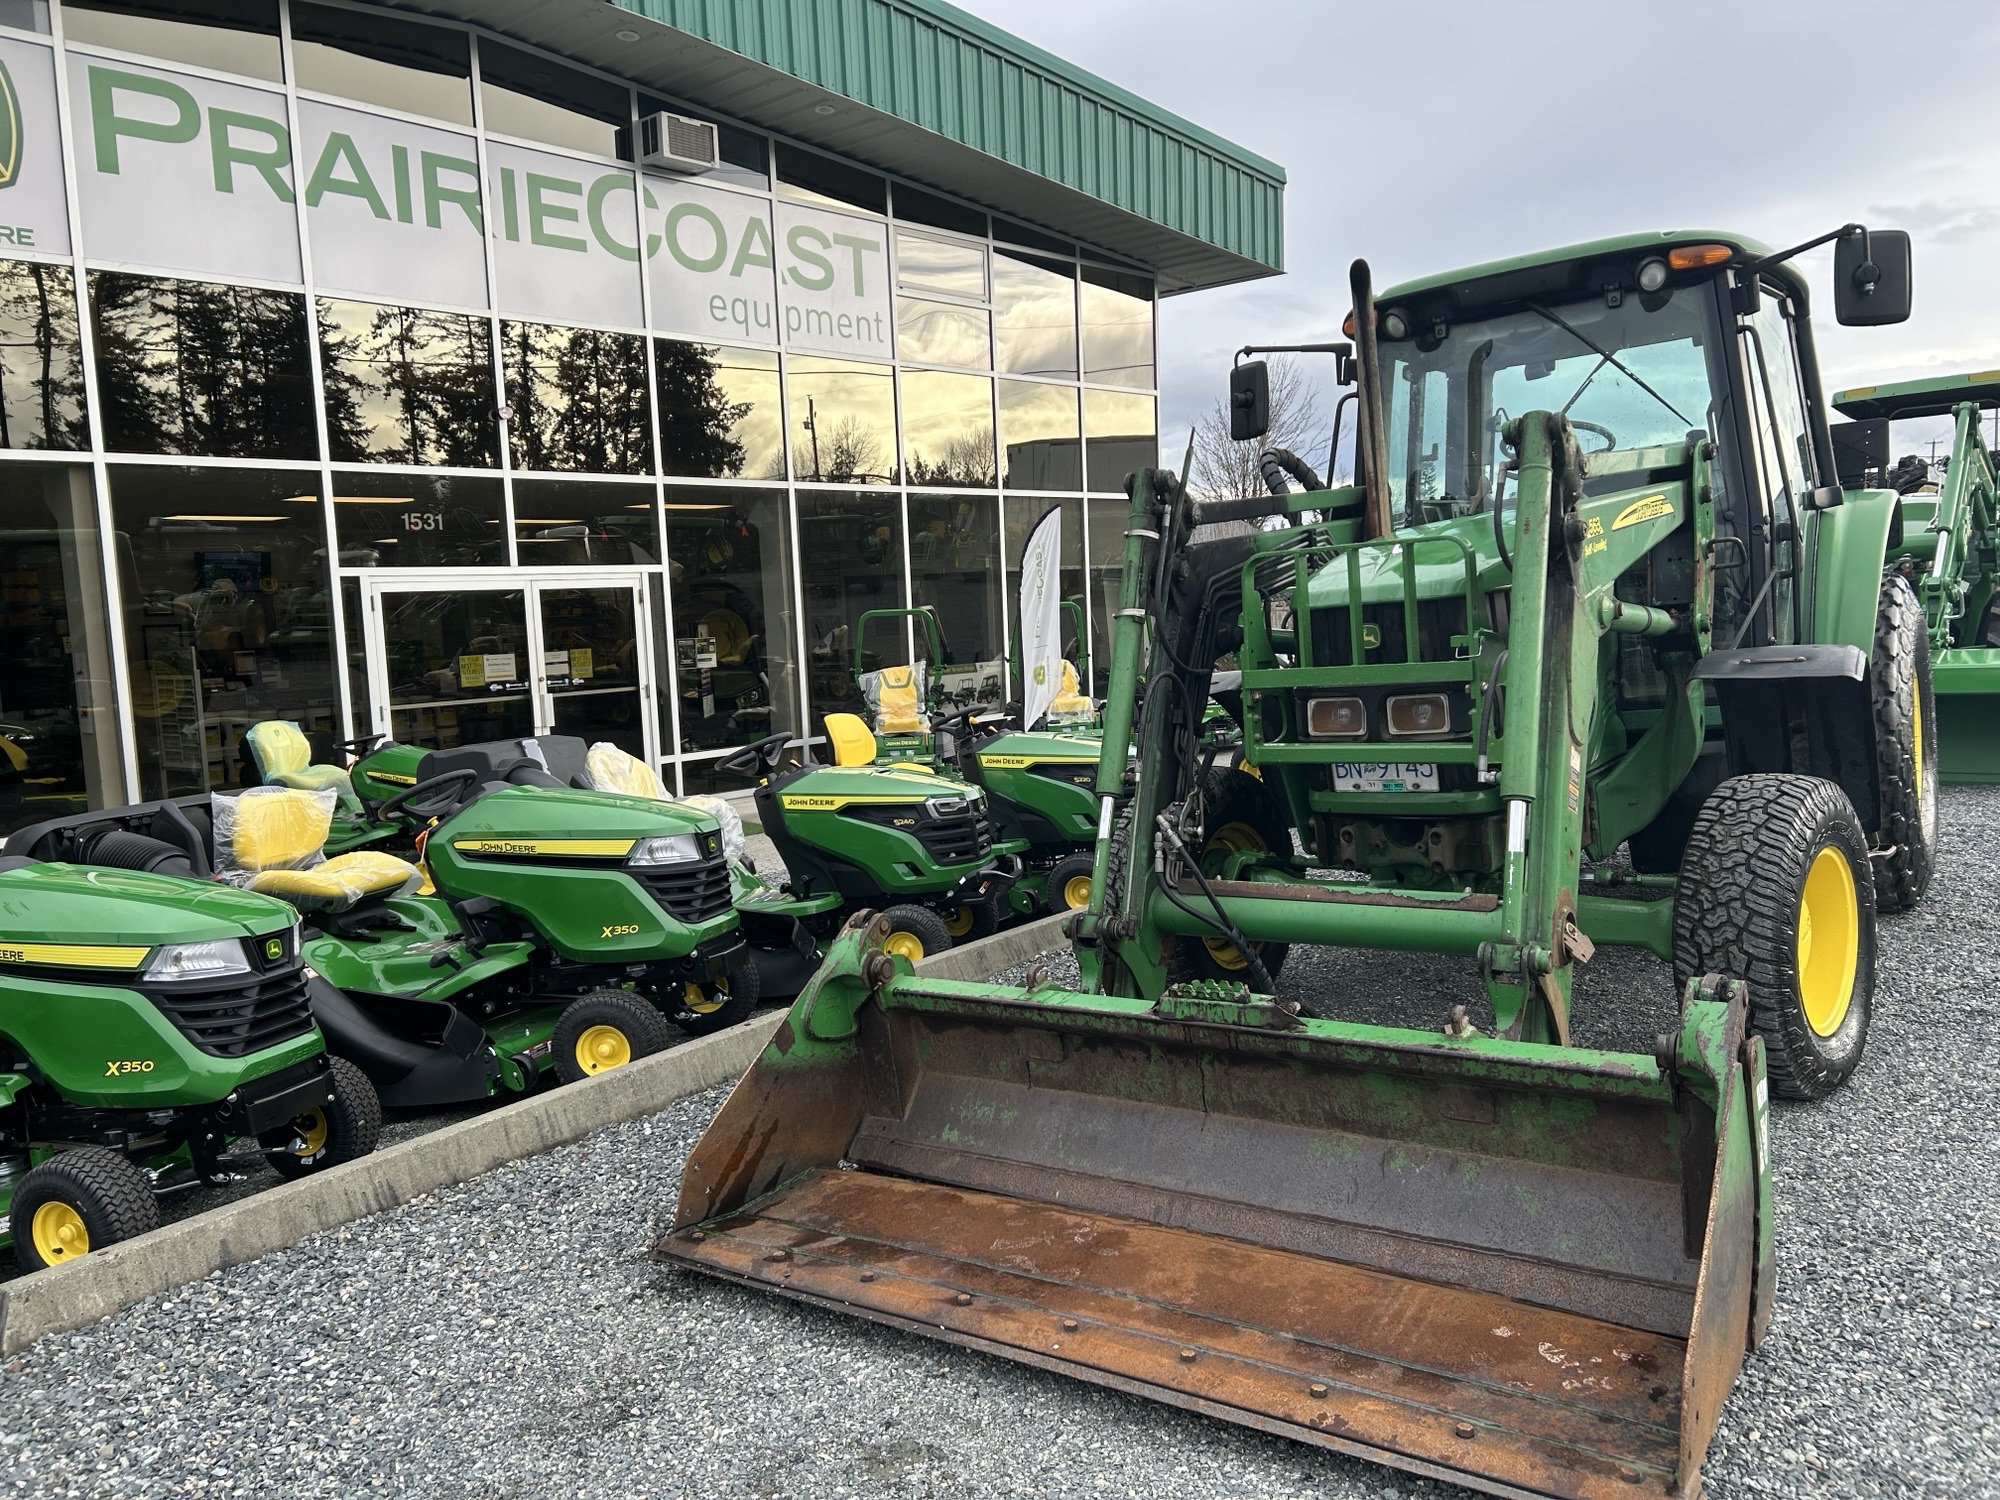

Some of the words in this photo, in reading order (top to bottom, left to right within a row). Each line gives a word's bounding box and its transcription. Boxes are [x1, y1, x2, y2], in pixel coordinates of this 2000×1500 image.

[709, 295, 884, 343] equpment
[401, 513, 443, 530] 1531
[788, 798, 808, 806] JOHN
[809, 798, 836, 806] DEERE
[893, 818, 915, 826] S240
[479, 841, 503, 851] JOHN
[505, 842, 537, 853] DEERE
[600, 924, 639, 938] X350
[104, 1060, 155, 1076] X350
